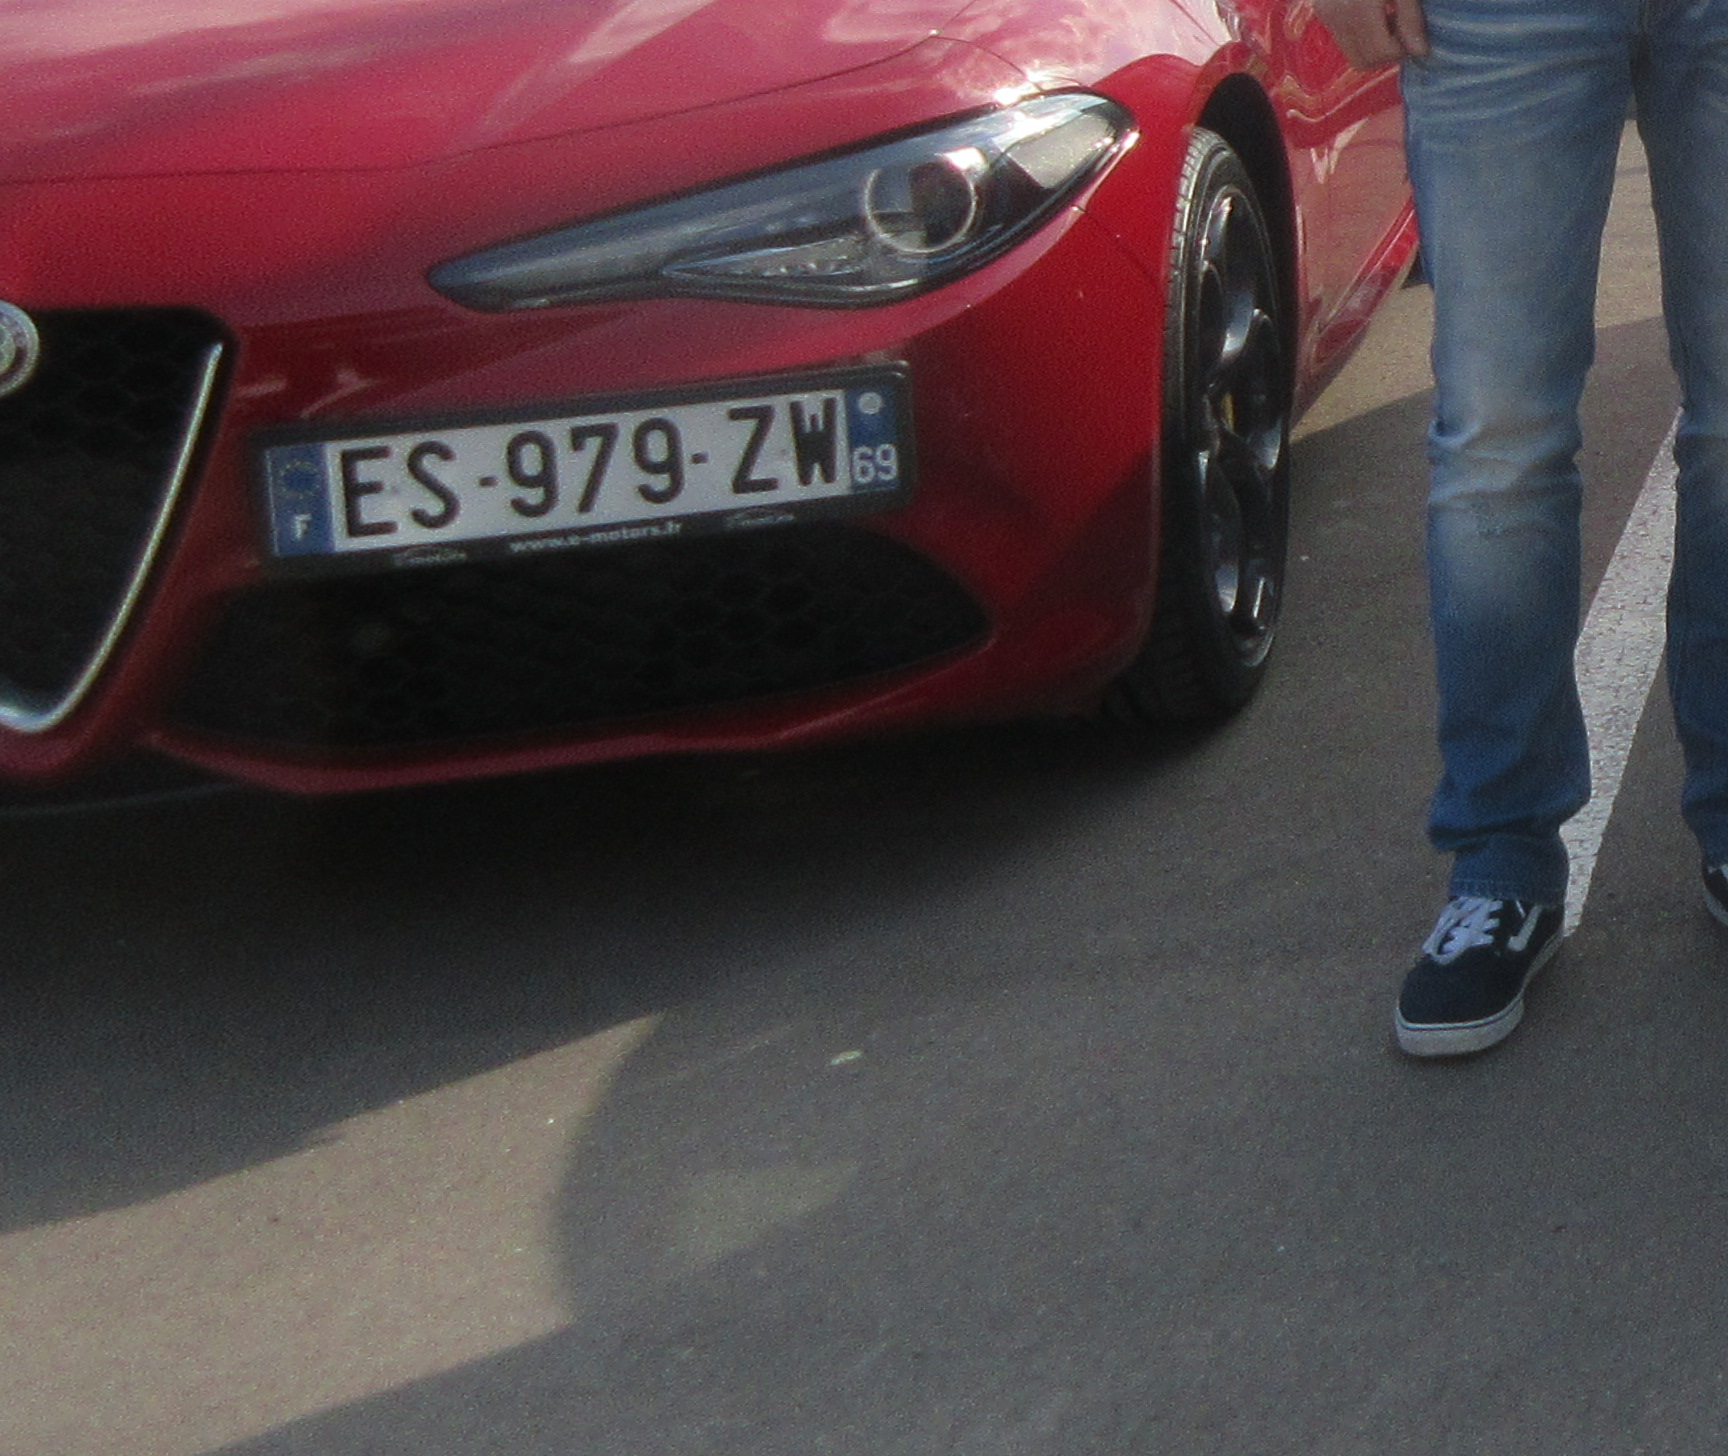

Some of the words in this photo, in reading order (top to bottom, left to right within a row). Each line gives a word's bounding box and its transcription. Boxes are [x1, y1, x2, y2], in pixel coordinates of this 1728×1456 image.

[340, 398, 838, 538] ES-979-ZW
[851, 447, 898, 484] 69
[292, 514, 309, 539] F
